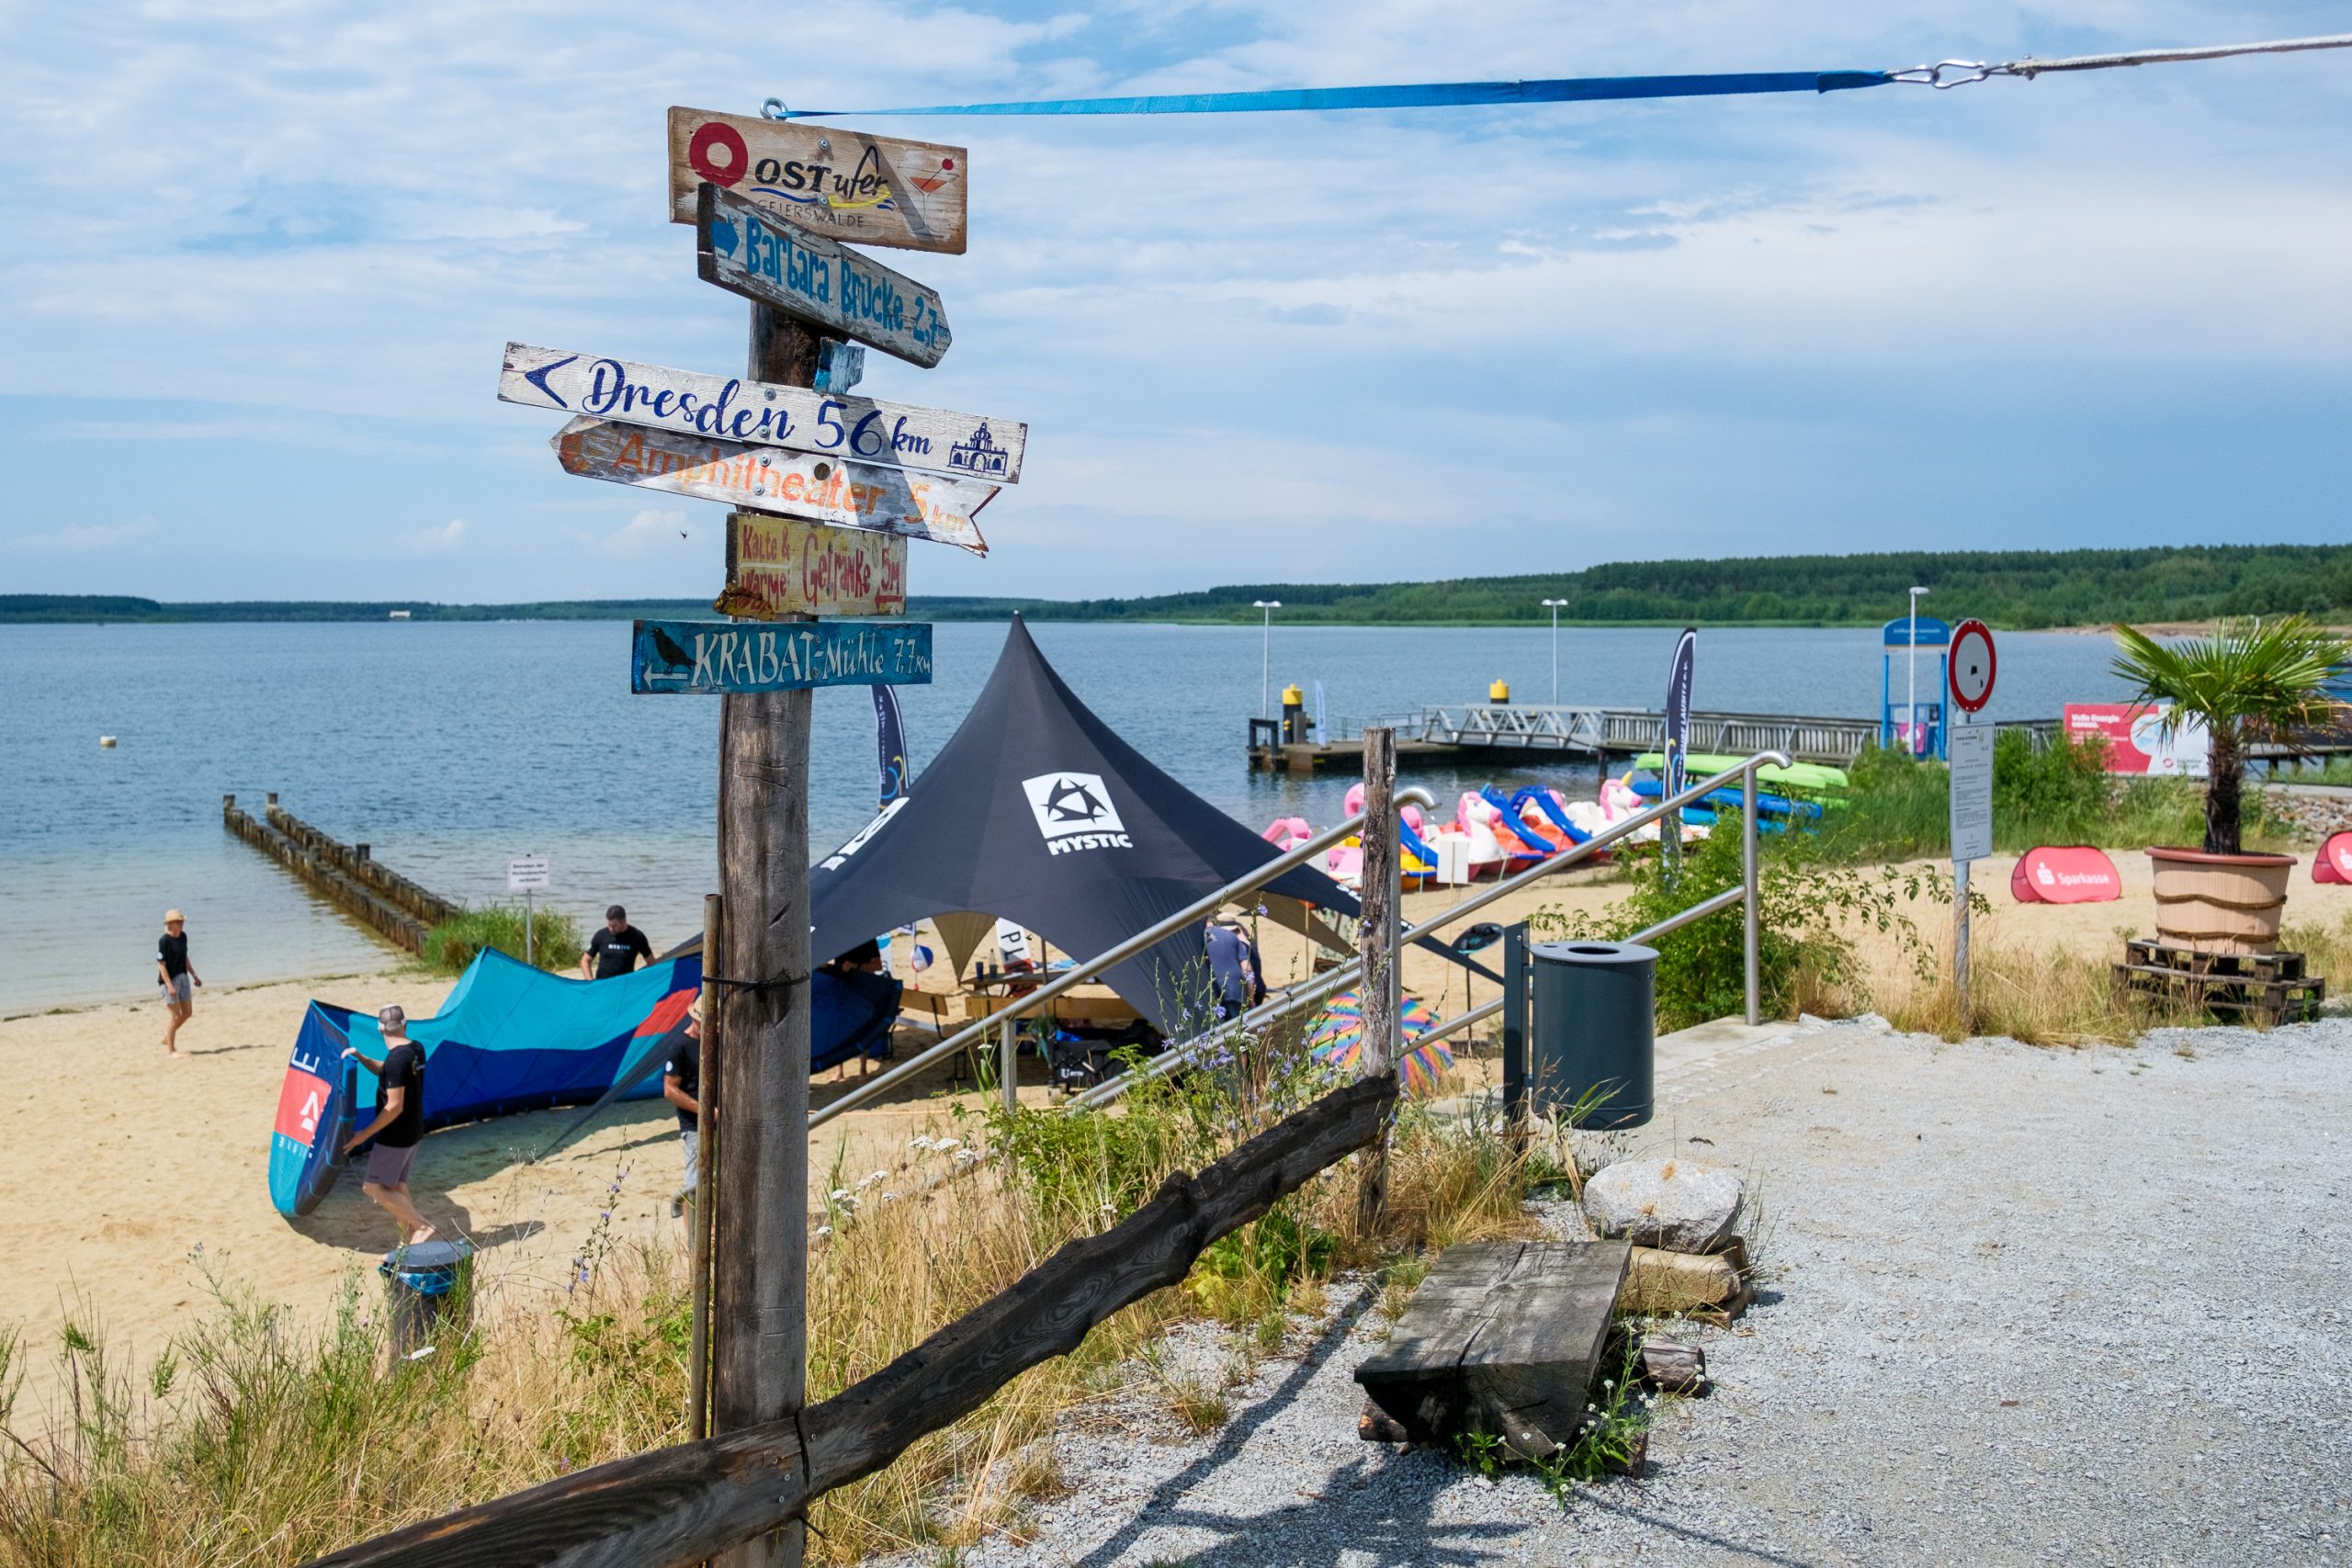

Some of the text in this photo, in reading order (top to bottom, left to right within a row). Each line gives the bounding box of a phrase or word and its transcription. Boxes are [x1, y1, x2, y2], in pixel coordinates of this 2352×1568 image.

[746, 216, 830, 304] Barbara
[582, 358, 933, 457] Dresden 56 km
[613, 432, 965, 532] Amphitheater 5 km
[690, 630, 884, 688] KRABAT-Mühle
[1046, 833, 1134, 856] MYSTIC
[2057, 872, 2110, 886] Sparkasse
